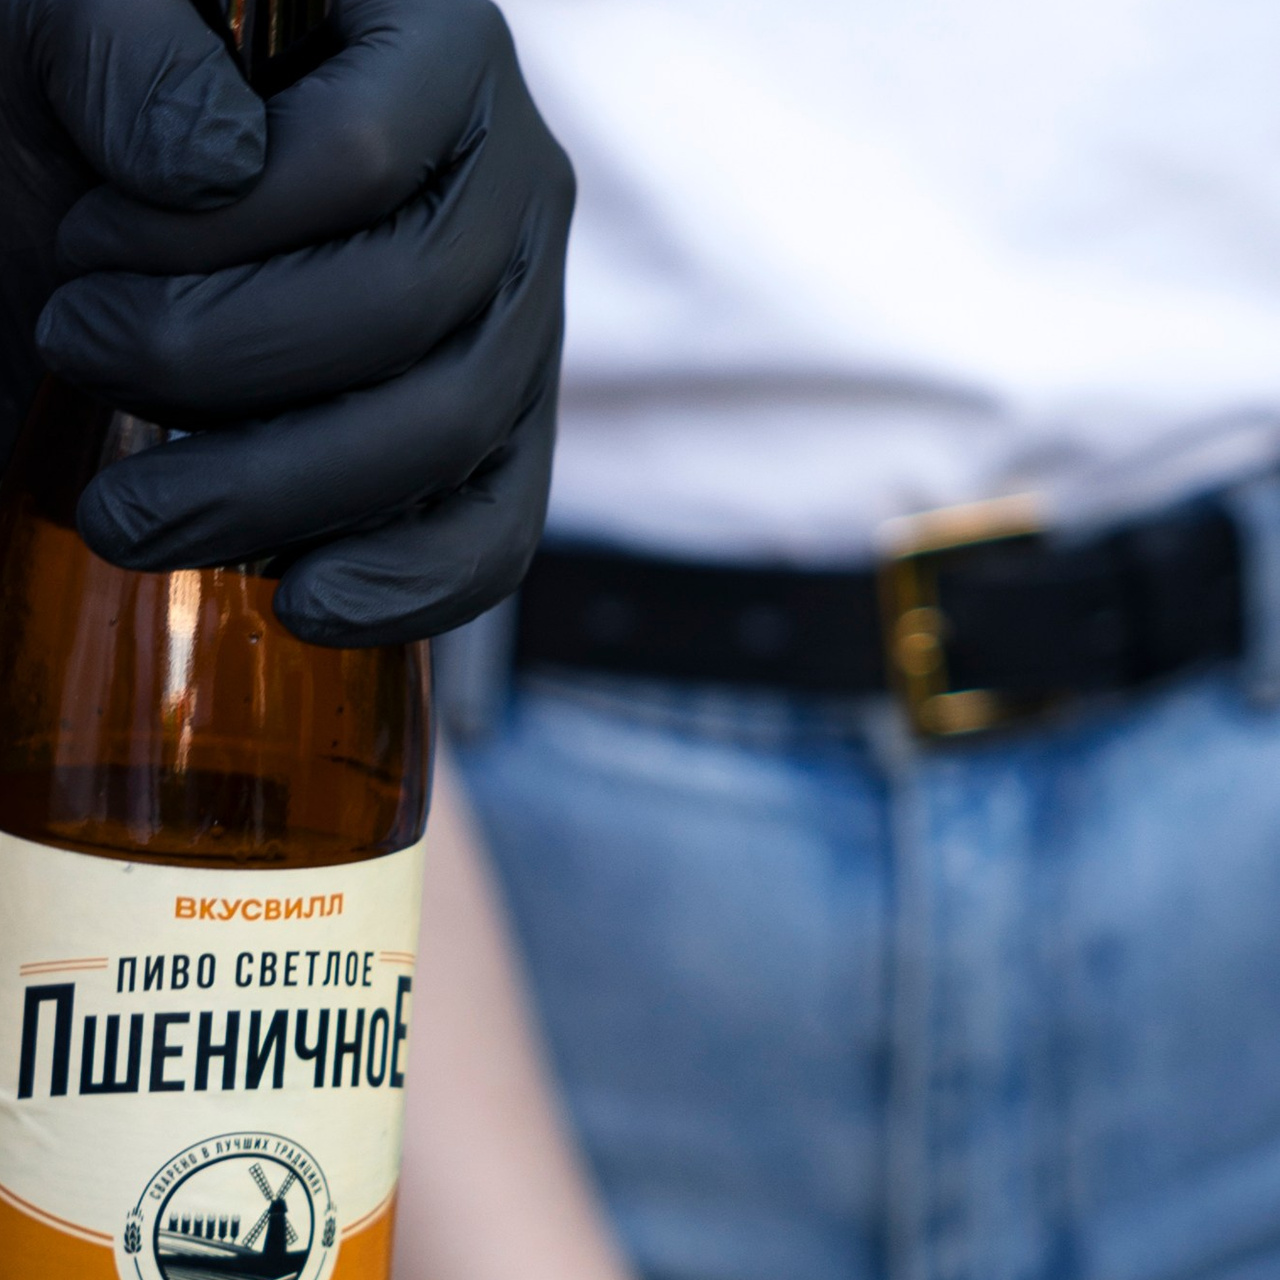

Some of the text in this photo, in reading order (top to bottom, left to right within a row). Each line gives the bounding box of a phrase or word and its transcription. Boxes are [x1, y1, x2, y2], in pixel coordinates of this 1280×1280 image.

[174, 893, 344, 920] ВКУСВИЛЛ
[116, 950, 375, 993] ПИВО СВЕТЛОЕ
[149, 1137, 323, 1201] СВАРЕНО В ЛУЧШИХ ТРАДИЦИЯХ
